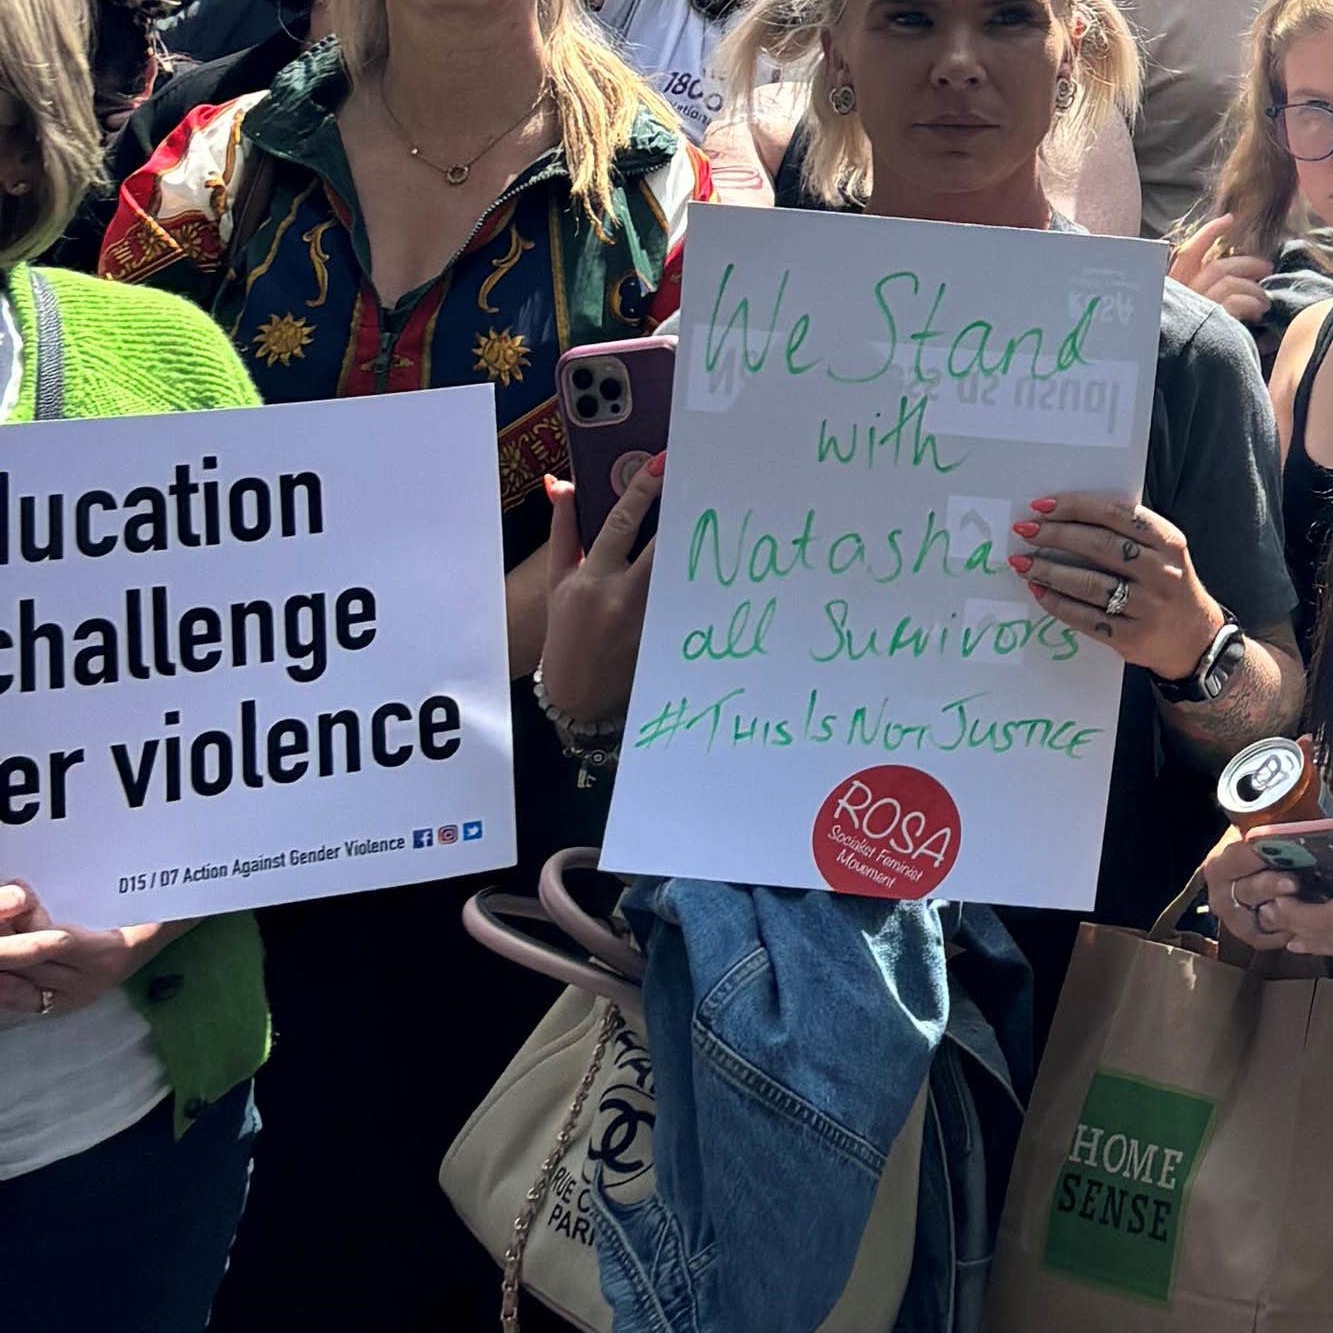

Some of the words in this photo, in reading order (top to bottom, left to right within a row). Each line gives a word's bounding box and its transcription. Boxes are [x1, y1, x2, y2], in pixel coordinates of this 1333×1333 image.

[704, 263, 823, 374] We
[828, 271, 1100, 384] Stand
[818, 396, 968, 473] with
[0, 456, 324, 565] ucation
[688, 508, 1003, 588] Natasha
[682, 597, 777, 661] all
[809, 599, 1080, 664] Survivors
[111, 695, 463, 808] violence
[828, 825, 876, 857] Socialist
[876, 849, 924, 882] Feminist
[834, 780, 952, 868] ROSA
[119, 874, 147, 894] D15
[160, 869, 178, 887] D7
[183, 864, 228, 884] Action
[232, 853, 286, 878] Against
[290, 843, 341, 866] Gender
[345, 835, 405, 857] Violence
[837, 849, 897, 889] Movement
[1068, 1124, 1184, 1191] HOME
[1056, 1173, 1172, 1243] SENSE
